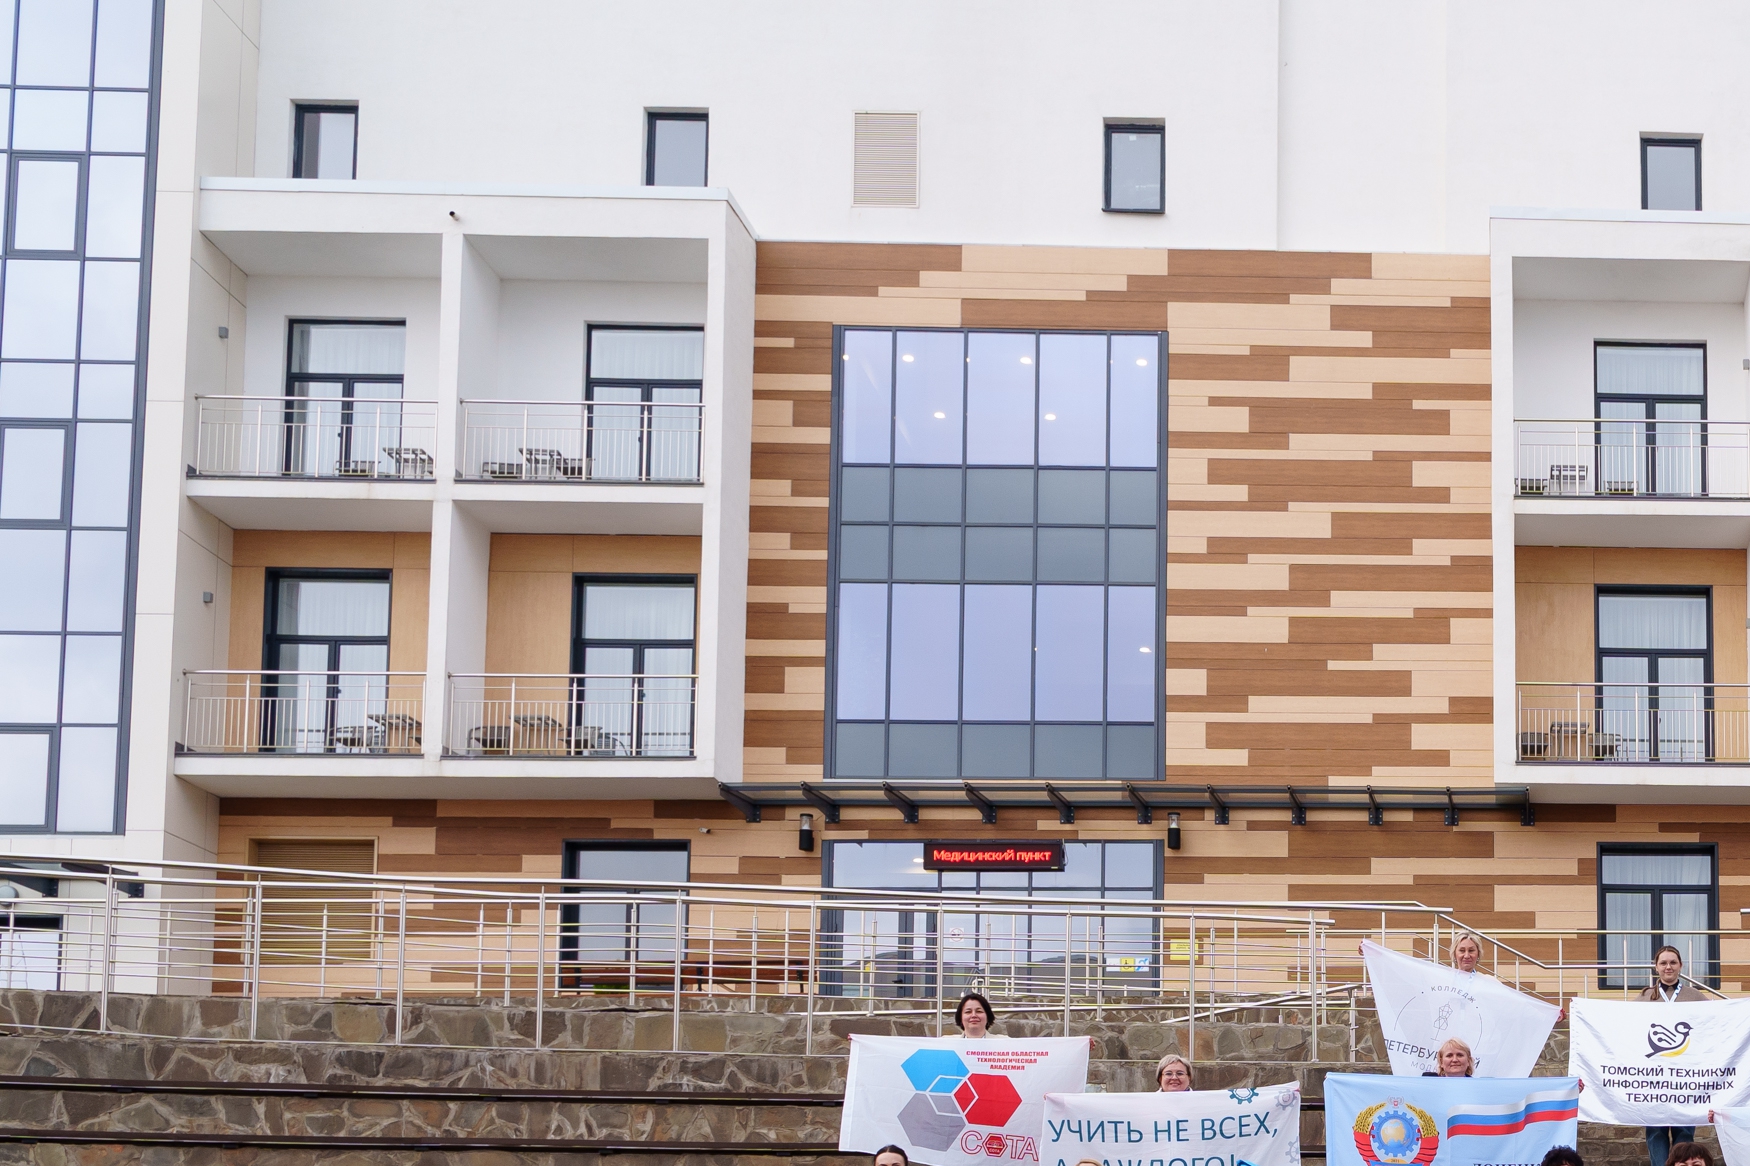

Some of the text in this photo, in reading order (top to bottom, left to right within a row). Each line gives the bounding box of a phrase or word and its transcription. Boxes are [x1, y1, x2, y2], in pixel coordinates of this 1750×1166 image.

[933, 849, 1051, 862] Медицинский пункт
[1430, 985, 1476, 1003] КОЛЛЕДЖ
[1601, 1065, 1736, 1078] ТОМСКИЙ ТЕХНИКУМ
[1603, 1079, 1734, 1091] ИНФОРМАЦИОННЫХ
[1626, 1092, 1711, 1104] ТЕХНОЛОГИЙ
[1048, 1111, 1278, 1143] УЧИТЬ НЕ ВСЕХ,
[960, 1130, 1039, 1162] СОТА
